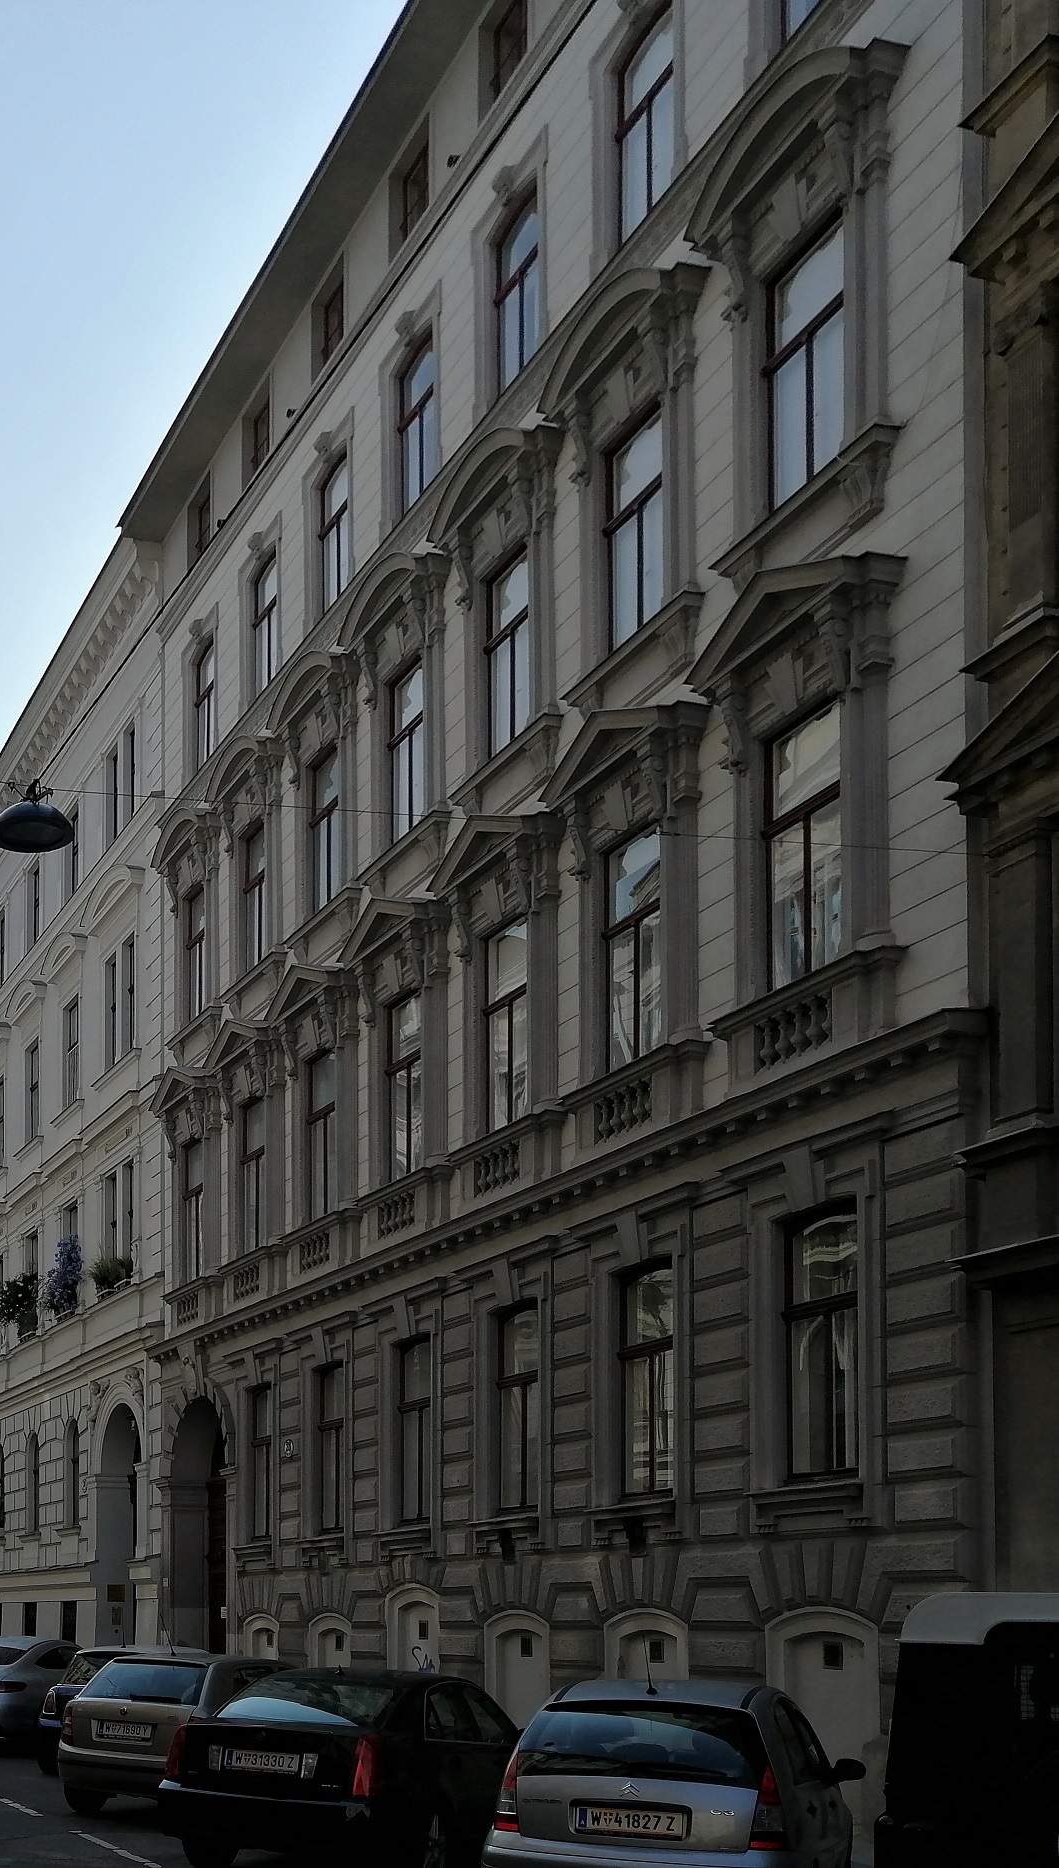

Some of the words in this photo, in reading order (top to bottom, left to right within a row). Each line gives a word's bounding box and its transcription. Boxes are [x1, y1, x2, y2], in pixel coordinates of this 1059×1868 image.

[105, 1723, 112, 1733] W
[116, 1724, 141, 1736] 71690
[142, 1726, 149, 1736] Y
[235, 1752, 244, 1764] W
[251, 1753, 285, 1767] 31330
[287, 1756, 295, 1768] Z
[591, 1811, 602, 1826] W
[614, 1812, 661, 1830] 41827
[666, 1815, 676, 1832] Z
